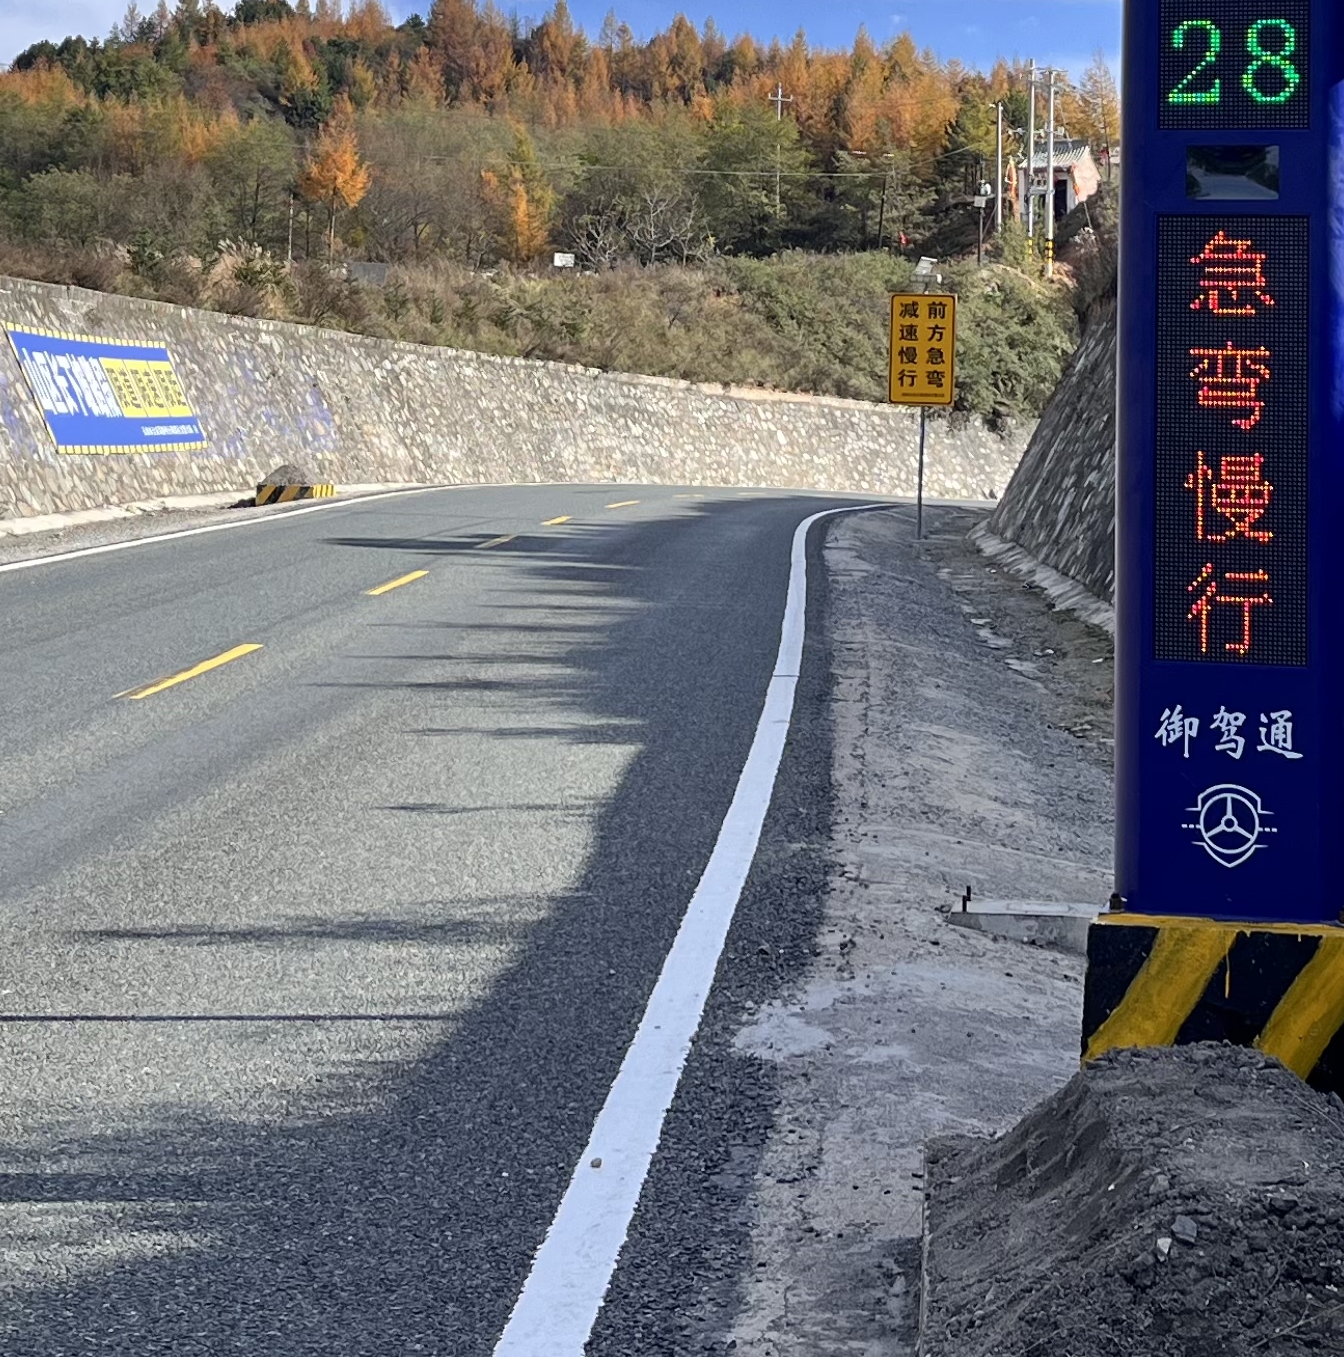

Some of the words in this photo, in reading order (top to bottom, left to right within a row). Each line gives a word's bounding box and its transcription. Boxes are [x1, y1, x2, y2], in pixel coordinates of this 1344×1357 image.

[1167, 18, 1300, 104] 28
[897, 300, 920, 388] 减速慢行
[925, 300, 948, 389] 前方急弯
[1186, 229, 1275, 655] 急弯慢行
[1154, 704, 1304, 760] 御驾通
